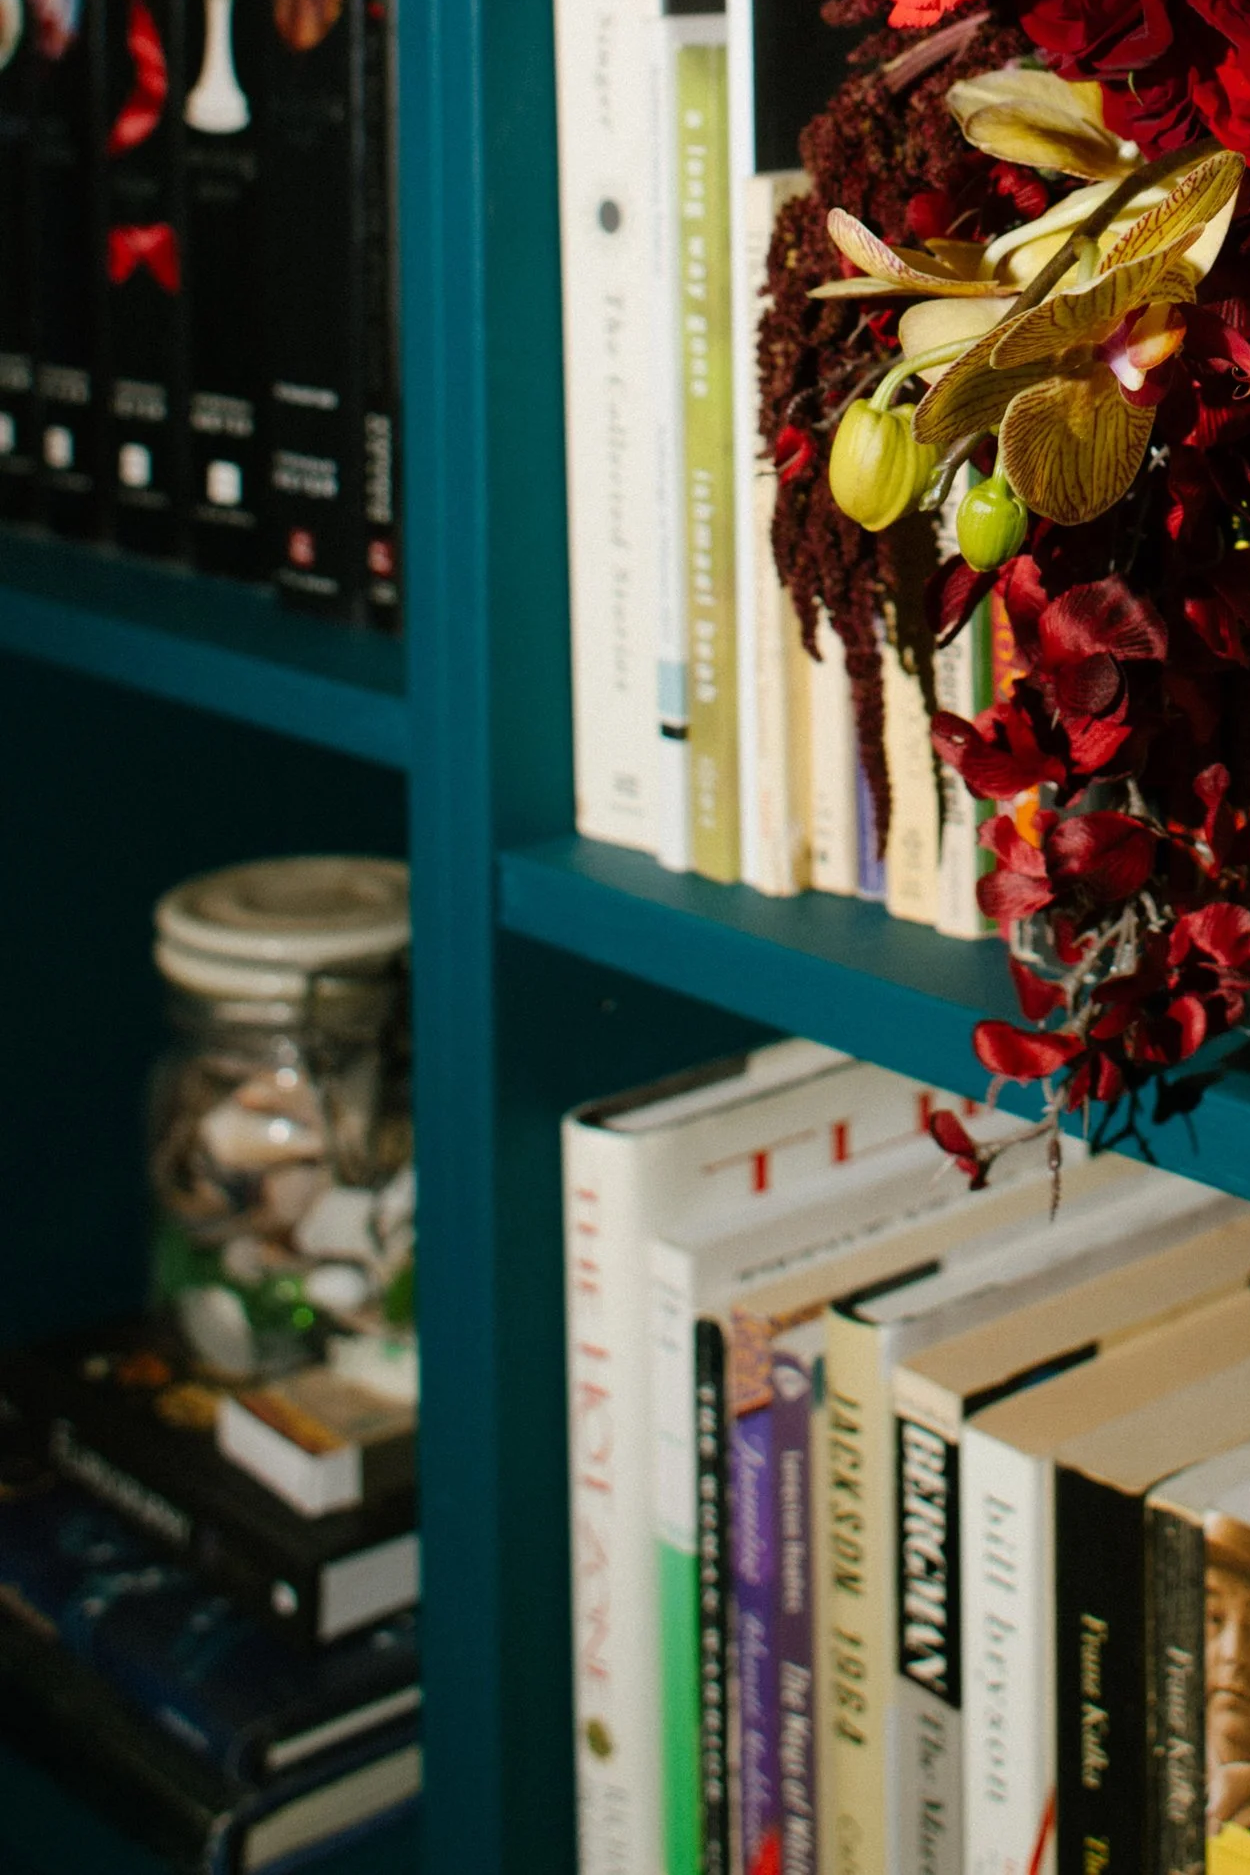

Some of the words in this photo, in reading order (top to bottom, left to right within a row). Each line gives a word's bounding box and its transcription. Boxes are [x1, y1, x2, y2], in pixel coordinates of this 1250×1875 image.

[828, 1389, 864, 1598] JACKSON
[984, 1492, 1018, 1596] bill
[901, 1422, 948, 1697] BERGMAN
[834, 1625, 868, 1749] 1984
[1079, 1611, 1109, 1698] Franz
[1080, 1702, 1110, 1791] Kafka
